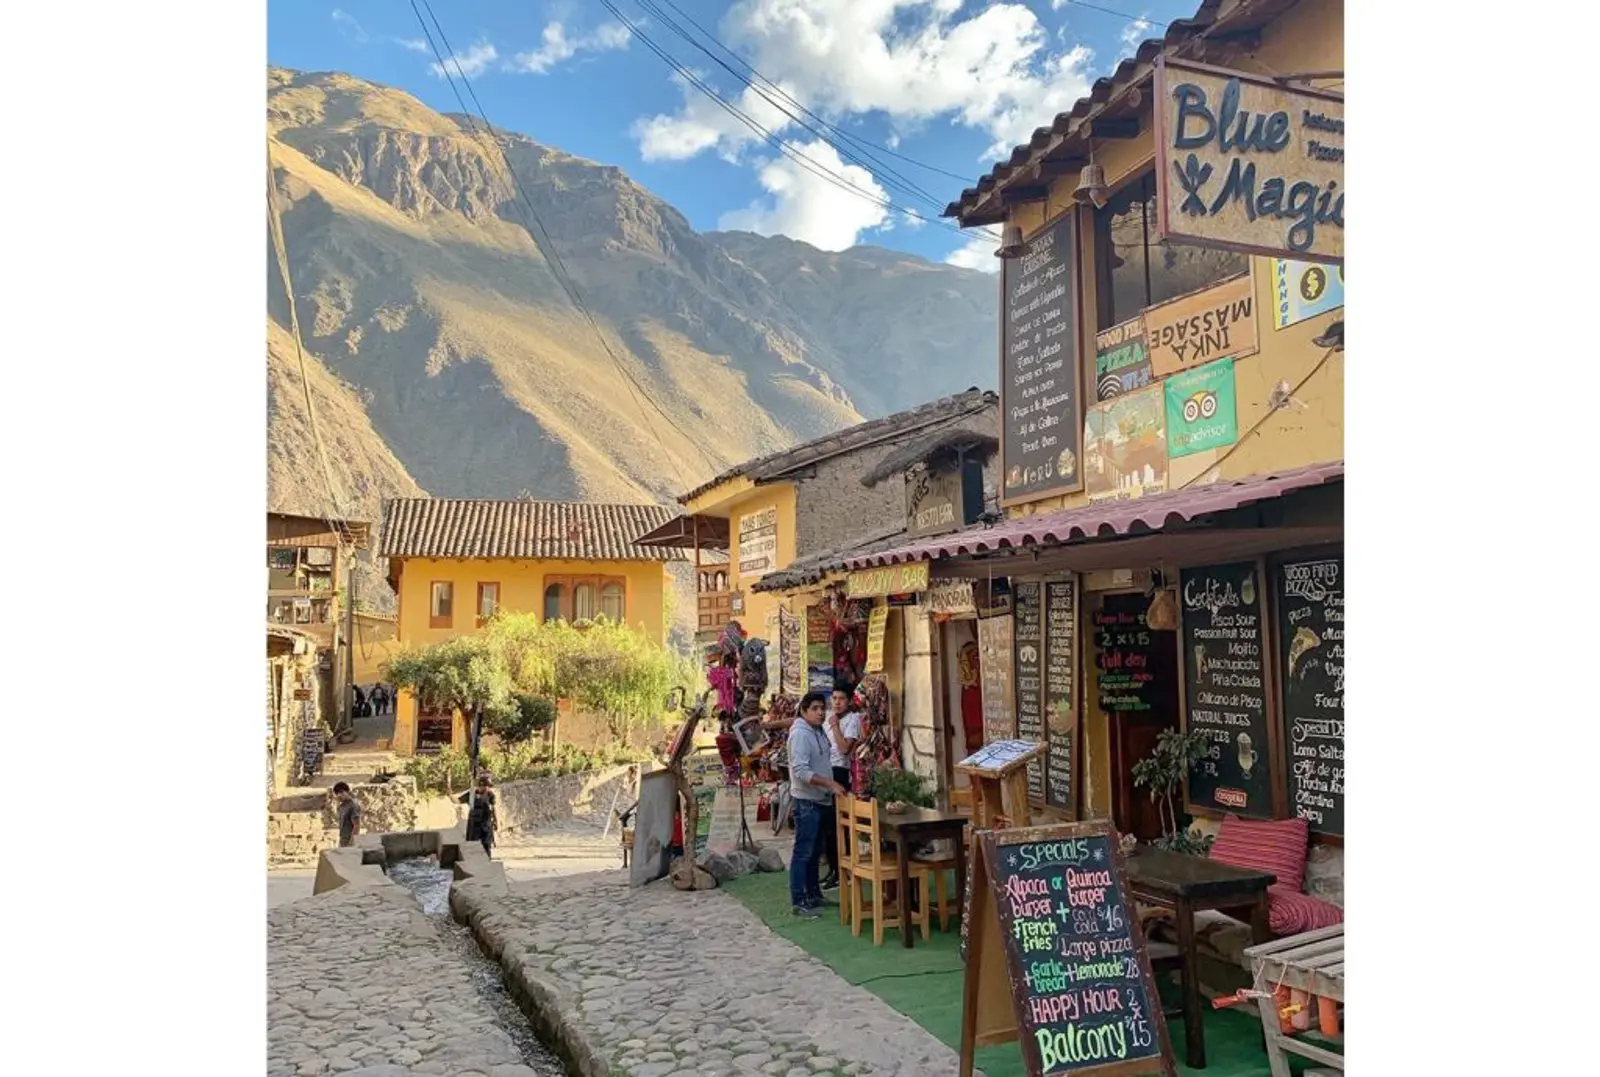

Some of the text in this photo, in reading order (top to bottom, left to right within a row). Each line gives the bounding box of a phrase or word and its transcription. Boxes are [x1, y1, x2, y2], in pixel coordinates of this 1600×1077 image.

[1173, 78, 1290, 152] Blue
[1150, 297, 1252, 350] MASSAGE
[1170, 325, 1231, 362] INKA
[1096, 342, 1144, 376] PIZZA
[900, 565, 927, 590] BAR
[1283, 562, 1339, 585] WOOD FIRED
[1235, 613, 1257, 627] Sour
[1239, 628, 1257, 639] Sour
[1228, 641, 1259, 657] Mojito
[1230, 673, 1261, 688] Colada
[1314, 693, 1340, 708] Four
[1192, 708, 1223, 725] NATURAL
[1292, 741, 1317, 758] Lomo
[1317, 762, 1331, 776] de
[1019, 839, 1090, 871] Specials
[1004, 868, 1113, 904] Alpaca or Quinoa
[1010, 887, 1107, 919] burger burger
[1012, 917, 1059, 939] French
[1023, 935, 1053, 953] fries
[1060, 937, 1133, 961] Large pizza
[1031, 958, 1066, 977] Garlic
[1033, 974, 1067, 993] bread
[1029, 988, 1124, 1023] HAPPY HOUR
[1126, 987, 1139, 1007] 2
[1034, 1022, 1127, 1073] Balcony
